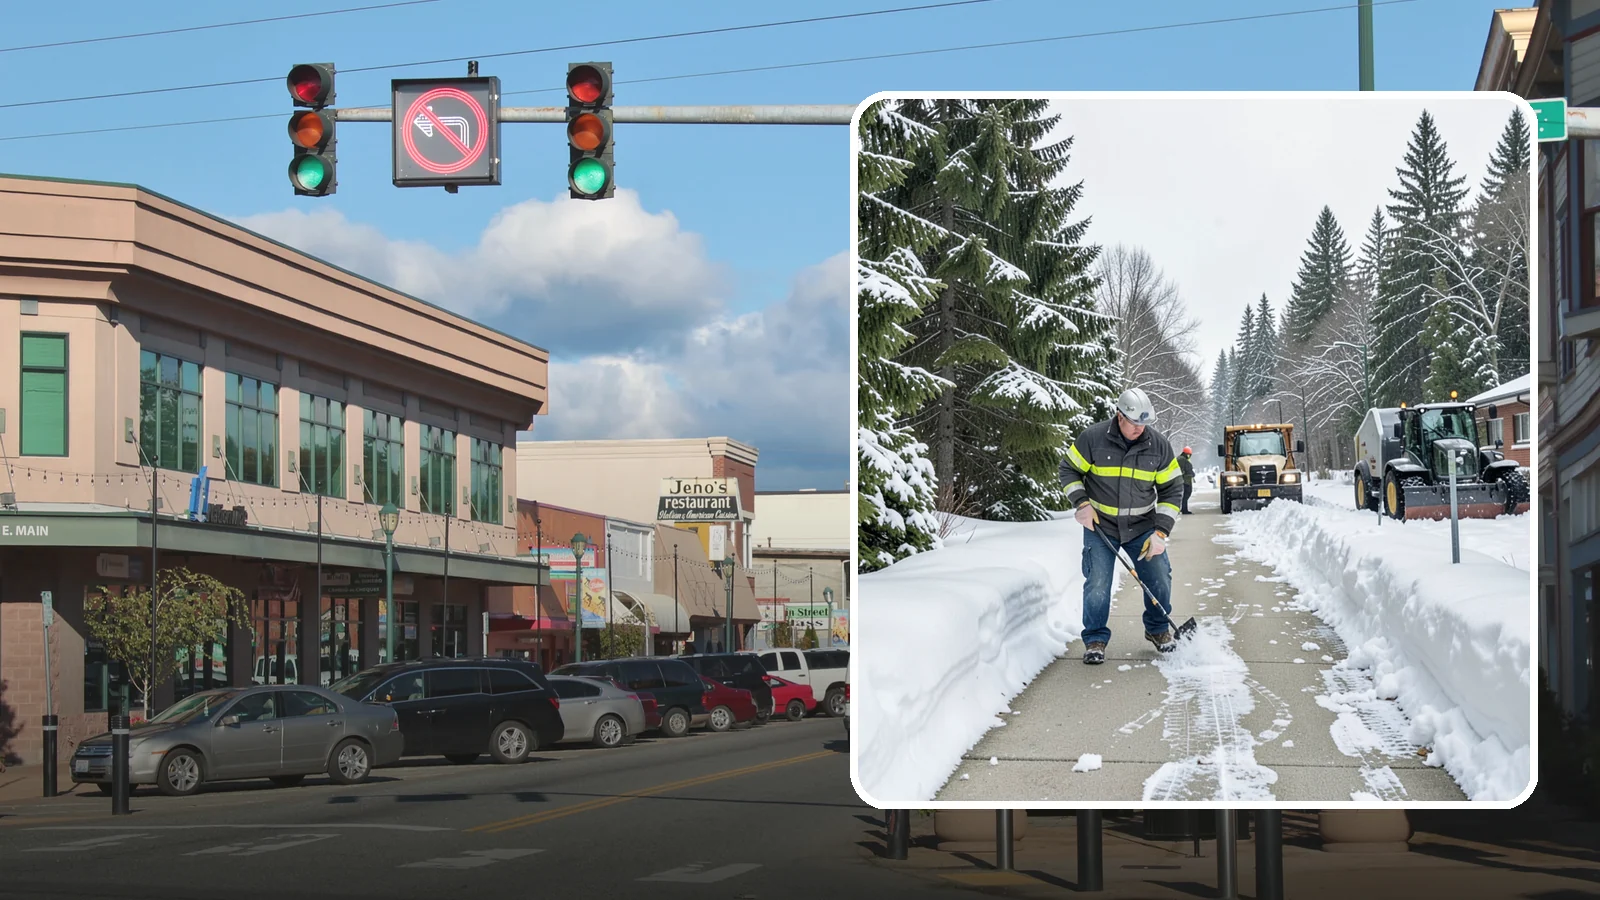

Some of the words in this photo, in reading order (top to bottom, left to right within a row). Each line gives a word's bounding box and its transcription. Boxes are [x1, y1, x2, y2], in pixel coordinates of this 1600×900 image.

[669, 480, 727, 494] Jeno's
[665, 496, 731, 509] restaurant
[659, 510, 681, 520] Italian
[686, 509, 714, 519] American
[715, 509, 737, 519] Cuisine
[2, 525, 13, 536] E.
[15, 525, 49, 536] MAIN
[797, 608, 828, 616] Street
